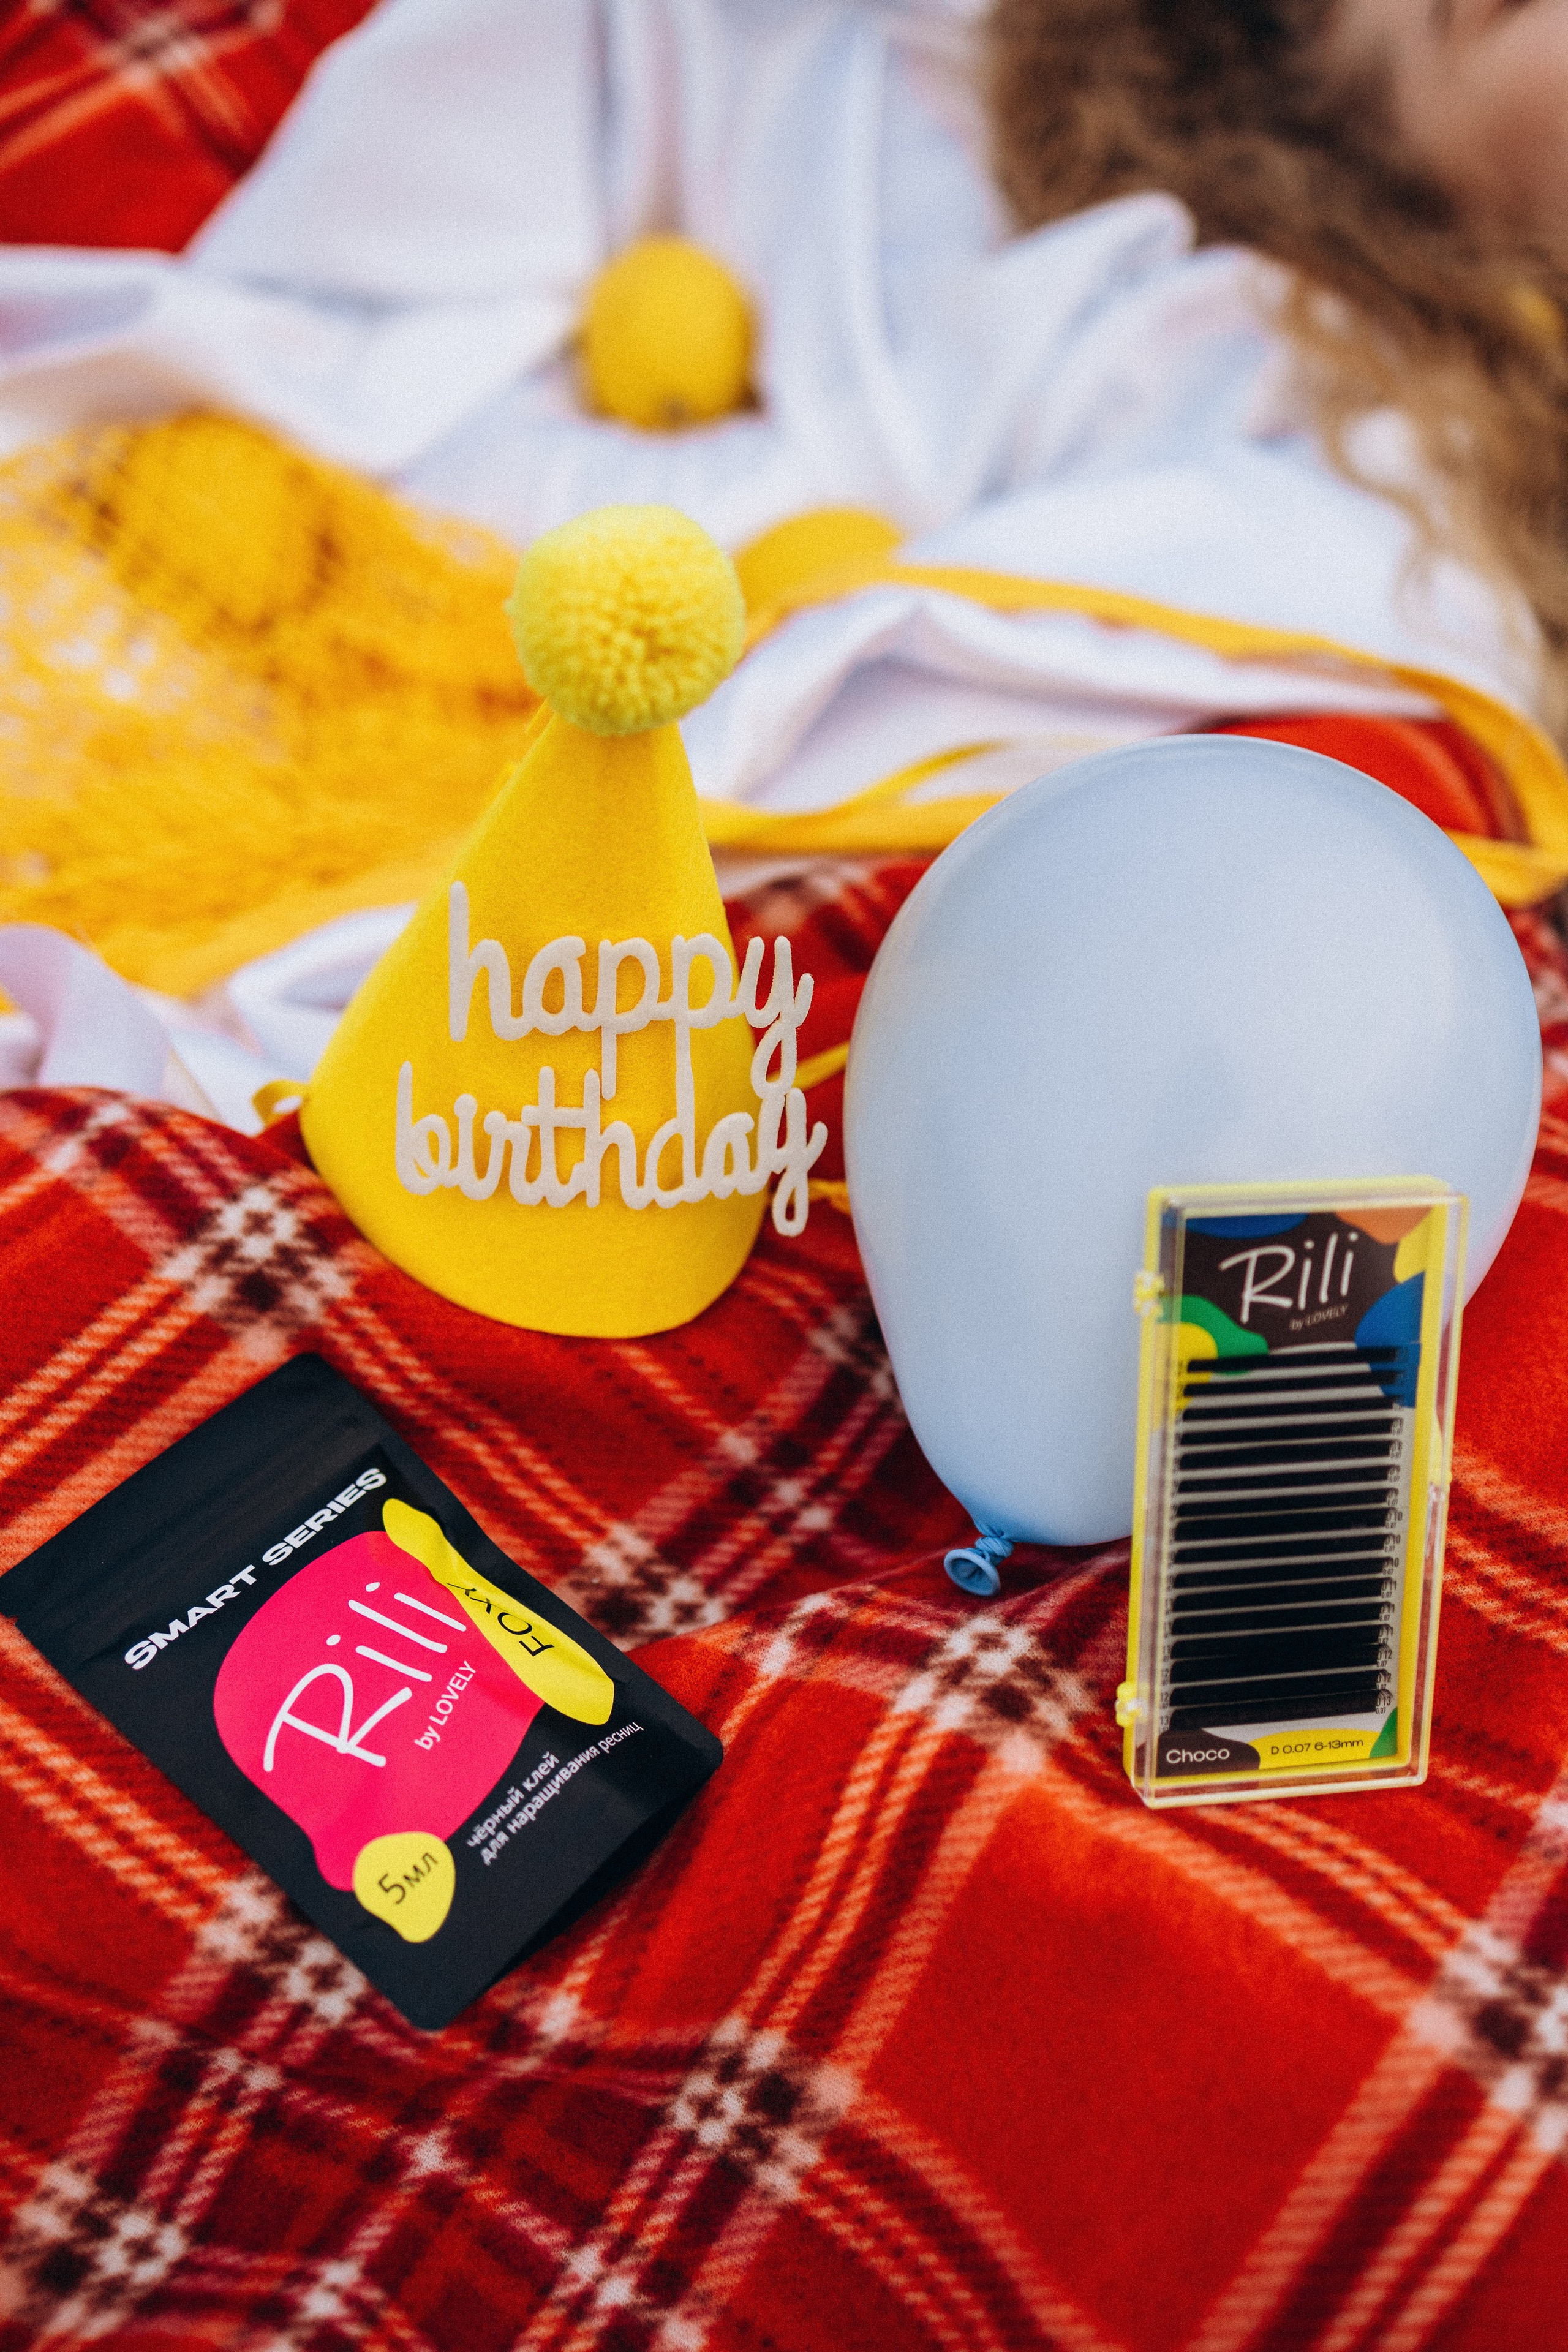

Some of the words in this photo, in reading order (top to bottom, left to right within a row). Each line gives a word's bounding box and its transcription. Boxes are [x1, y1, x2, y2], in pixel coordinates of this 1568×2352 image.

[449, 880, 814, 1100] happy
[395, 1060, 828, 1237] birthday
[1218, 1231, 1359, 1324] Rili
[1289, 1317, 1305, 1332] by
[1305, 1302, 1349, 1327] LOVELY
[124, 1564, 257, 1670] SMART
[262, 1468, 387, 1566] SERIES
[447, 1583, 555, 1657] FOXY
[263, 1582, 467, 1772] Rili
[414, 1725, 440, 1750] by
[429, 1660, 476, 1725] LOVELY
[481, 1830, 510, 1866] для
[507, 1746, 600, 1834] наращивания
[598, 1722, 644, 1754] ресниц
[1166, 1747, 1230, 1764] Choco
[1270, 1746, 1279, 1755] D
[1283, 1743, 1311, 1754] 0.07
[1314, 1740, 1363, 1751] 6-13mm
[467, 1785, 524, 1847] чёрный
[522, 1751, 559, 1792] клей
